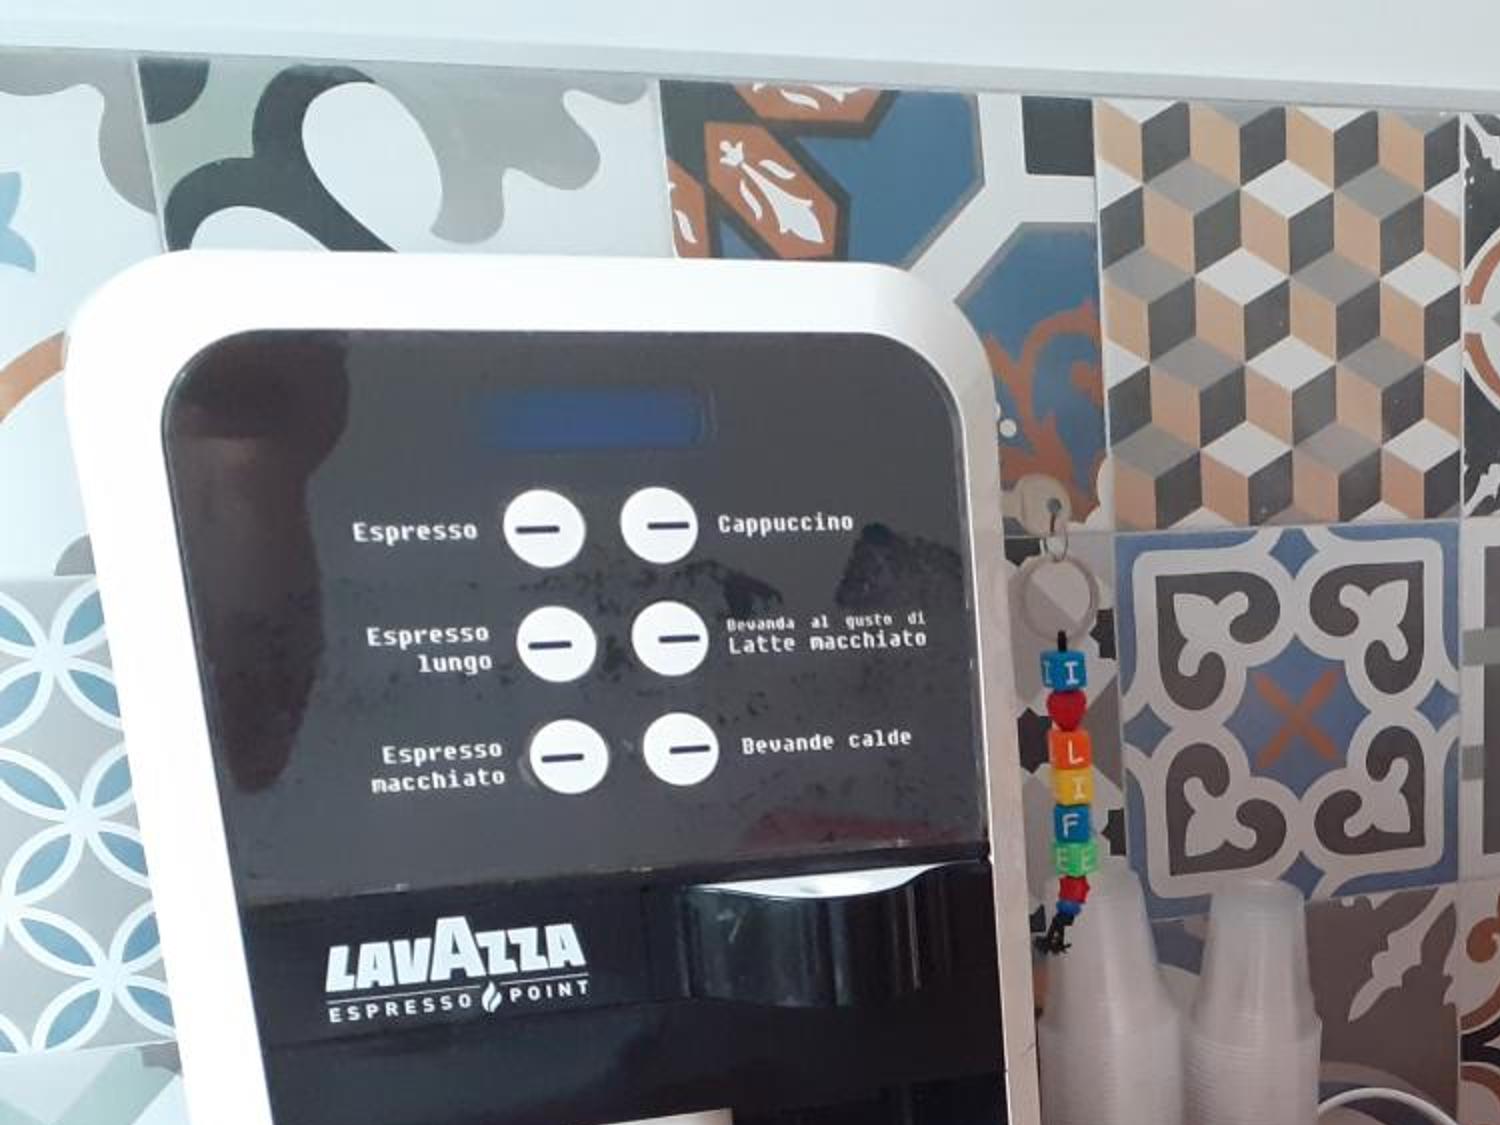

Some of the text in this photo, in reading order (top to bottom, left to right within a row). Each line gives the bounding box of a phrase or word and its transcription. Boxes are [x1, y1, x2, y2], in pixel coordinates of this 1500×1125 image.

[352, 521, 478, 547] Espresso
[717, 511, 854, 538] Cappuccino
[725, 610, 927, 633] Bevanda al gusto di
[365, 626, 490, 650] Espresso
[728, 629, 928, 655] Latte macchiato
[416, 653, 493, 676] lungo
[381, 742, 504, 768] Espresso
[740, 728, 913, 756] Bevande calde
[370, 767, 506, 794] macchiato
[325, 915, 586, 992] LAVAZZA
[328, 979, 590, 1023] ESPRESSO POINT
